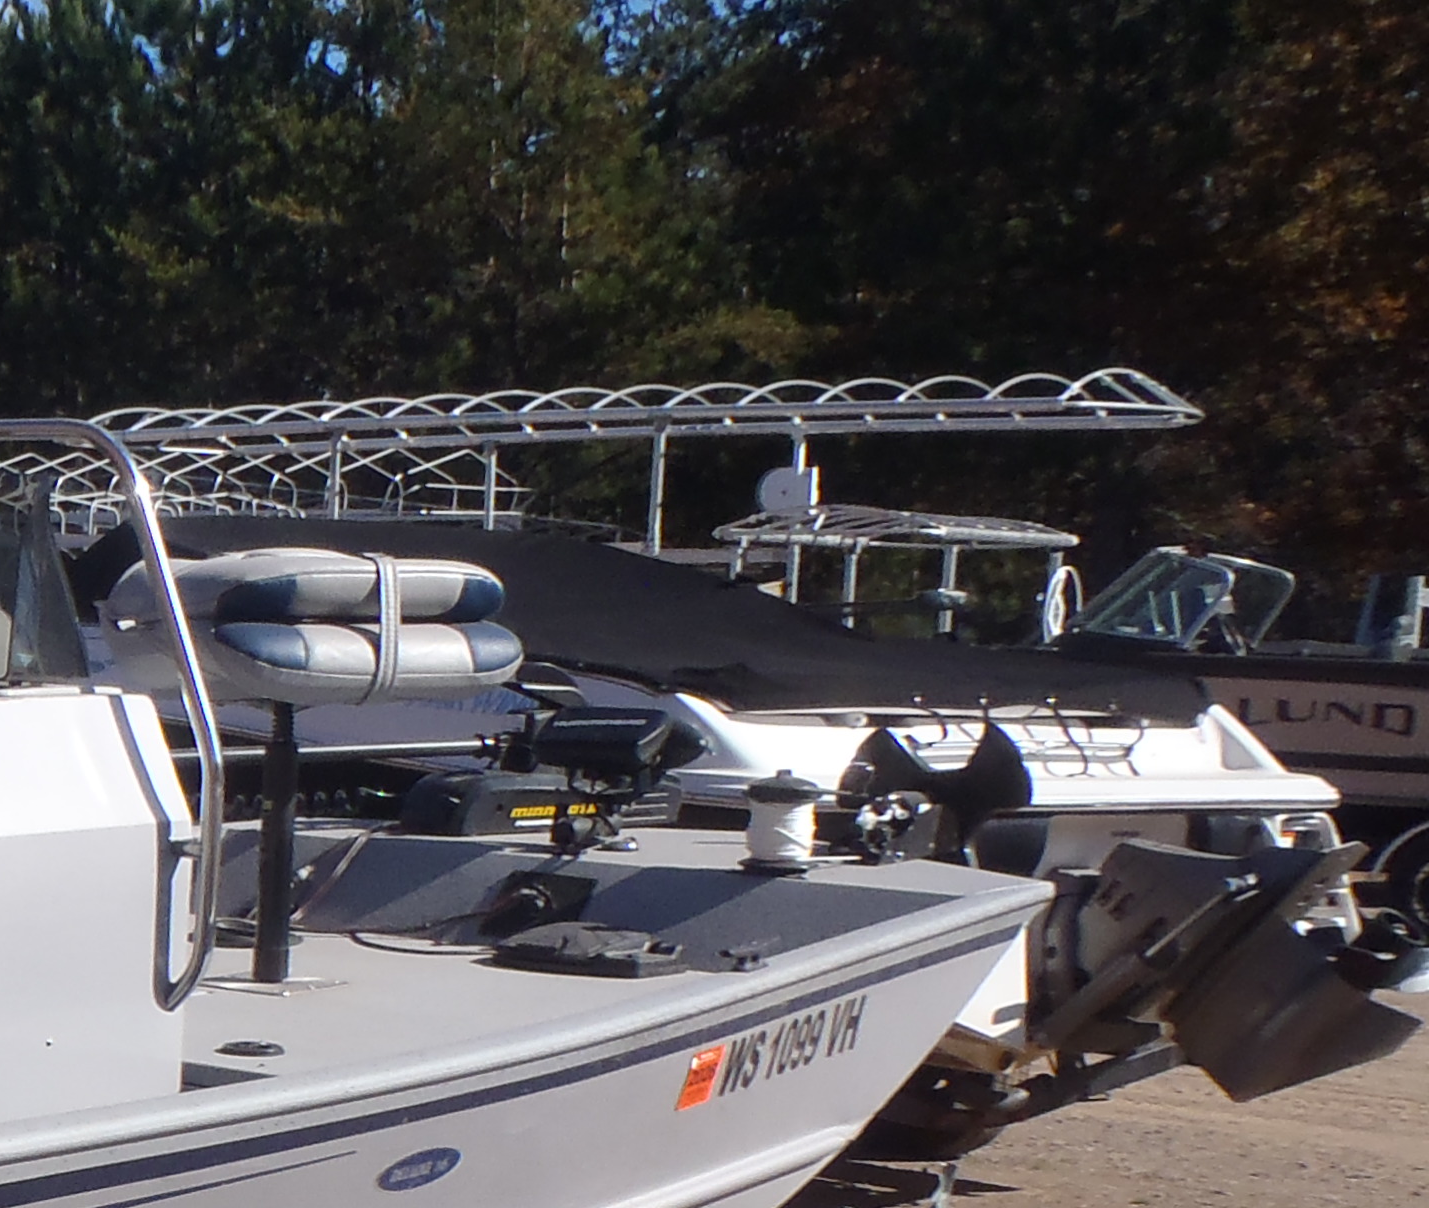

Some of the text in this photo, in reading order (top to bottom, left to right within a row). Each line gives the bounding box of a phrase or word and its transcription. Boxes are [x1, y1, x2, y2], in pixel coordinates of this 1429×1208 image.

[1238, 698, 1415, 737] LUND
[718, 994, 867, 1097] WS 1099 VH
